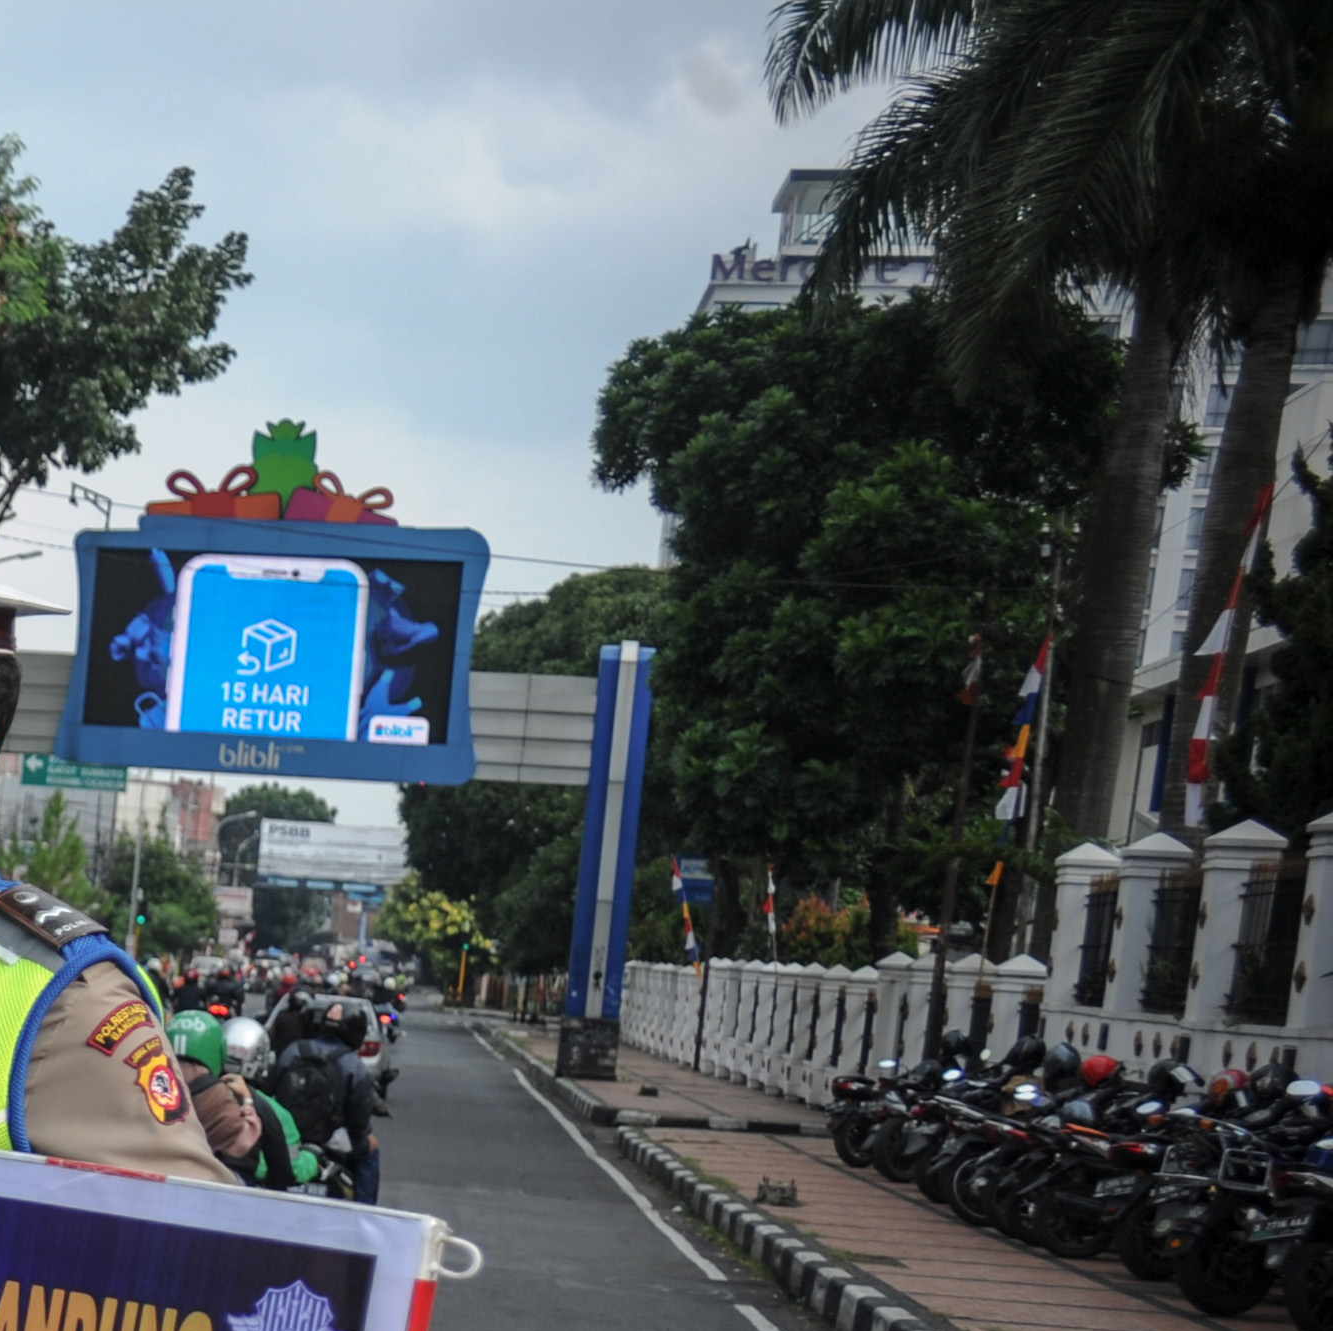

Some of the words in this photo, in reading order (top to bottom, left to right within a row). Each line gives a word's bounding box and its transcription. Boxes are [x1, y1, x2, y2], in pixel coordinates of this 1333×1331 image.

[711, 254, 901, 284] Merce
[221, 681, 247, 703] 15
[251, 683, 310, 706] HARI
[221, 707, 303, 733] RETUR
[269, 823, 311, 838] PSBB
